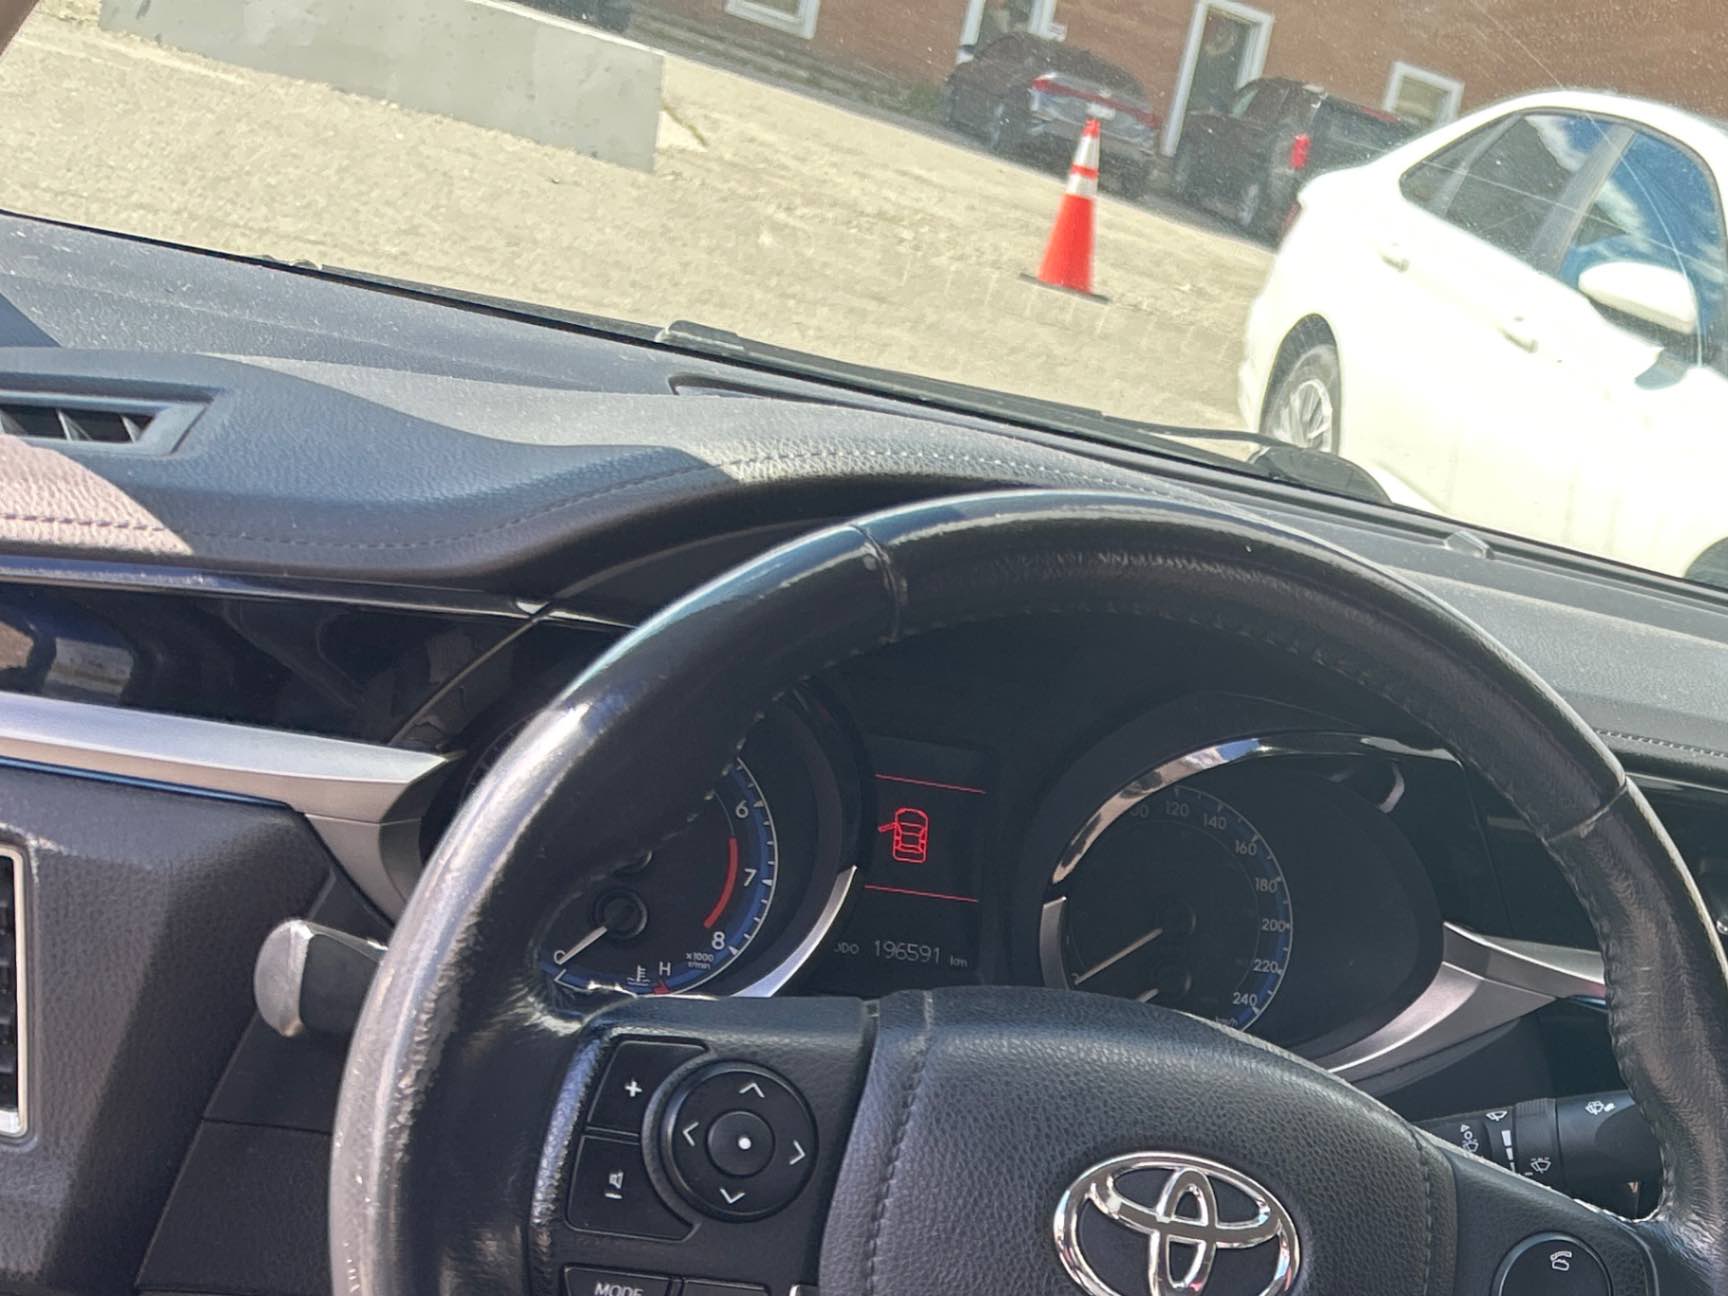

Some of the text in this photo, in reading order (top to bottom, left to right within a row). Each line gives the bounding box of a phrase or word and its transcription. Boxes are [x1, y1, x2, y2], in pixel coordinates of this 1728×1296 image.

[735, 799, 749, 818] 6
[1165, 801, 1190, 818] 120
[1203, 813, 1227, 830] 140
[1235, 839, 1257, 856] 160
[743, 868, 757, 887] 7
[1255, 877, 1278, 894] 180
[1262, 917, 1285, 933] 200
[711, 931, 725, 950] 8
[875, 940, 940, 963] 196591
[949, 955, 969, 968] km
[659, 961, 671, 976] H
[1253, 958, 1278, 973] 220
[1232, 991, 1258, 1006] 240
